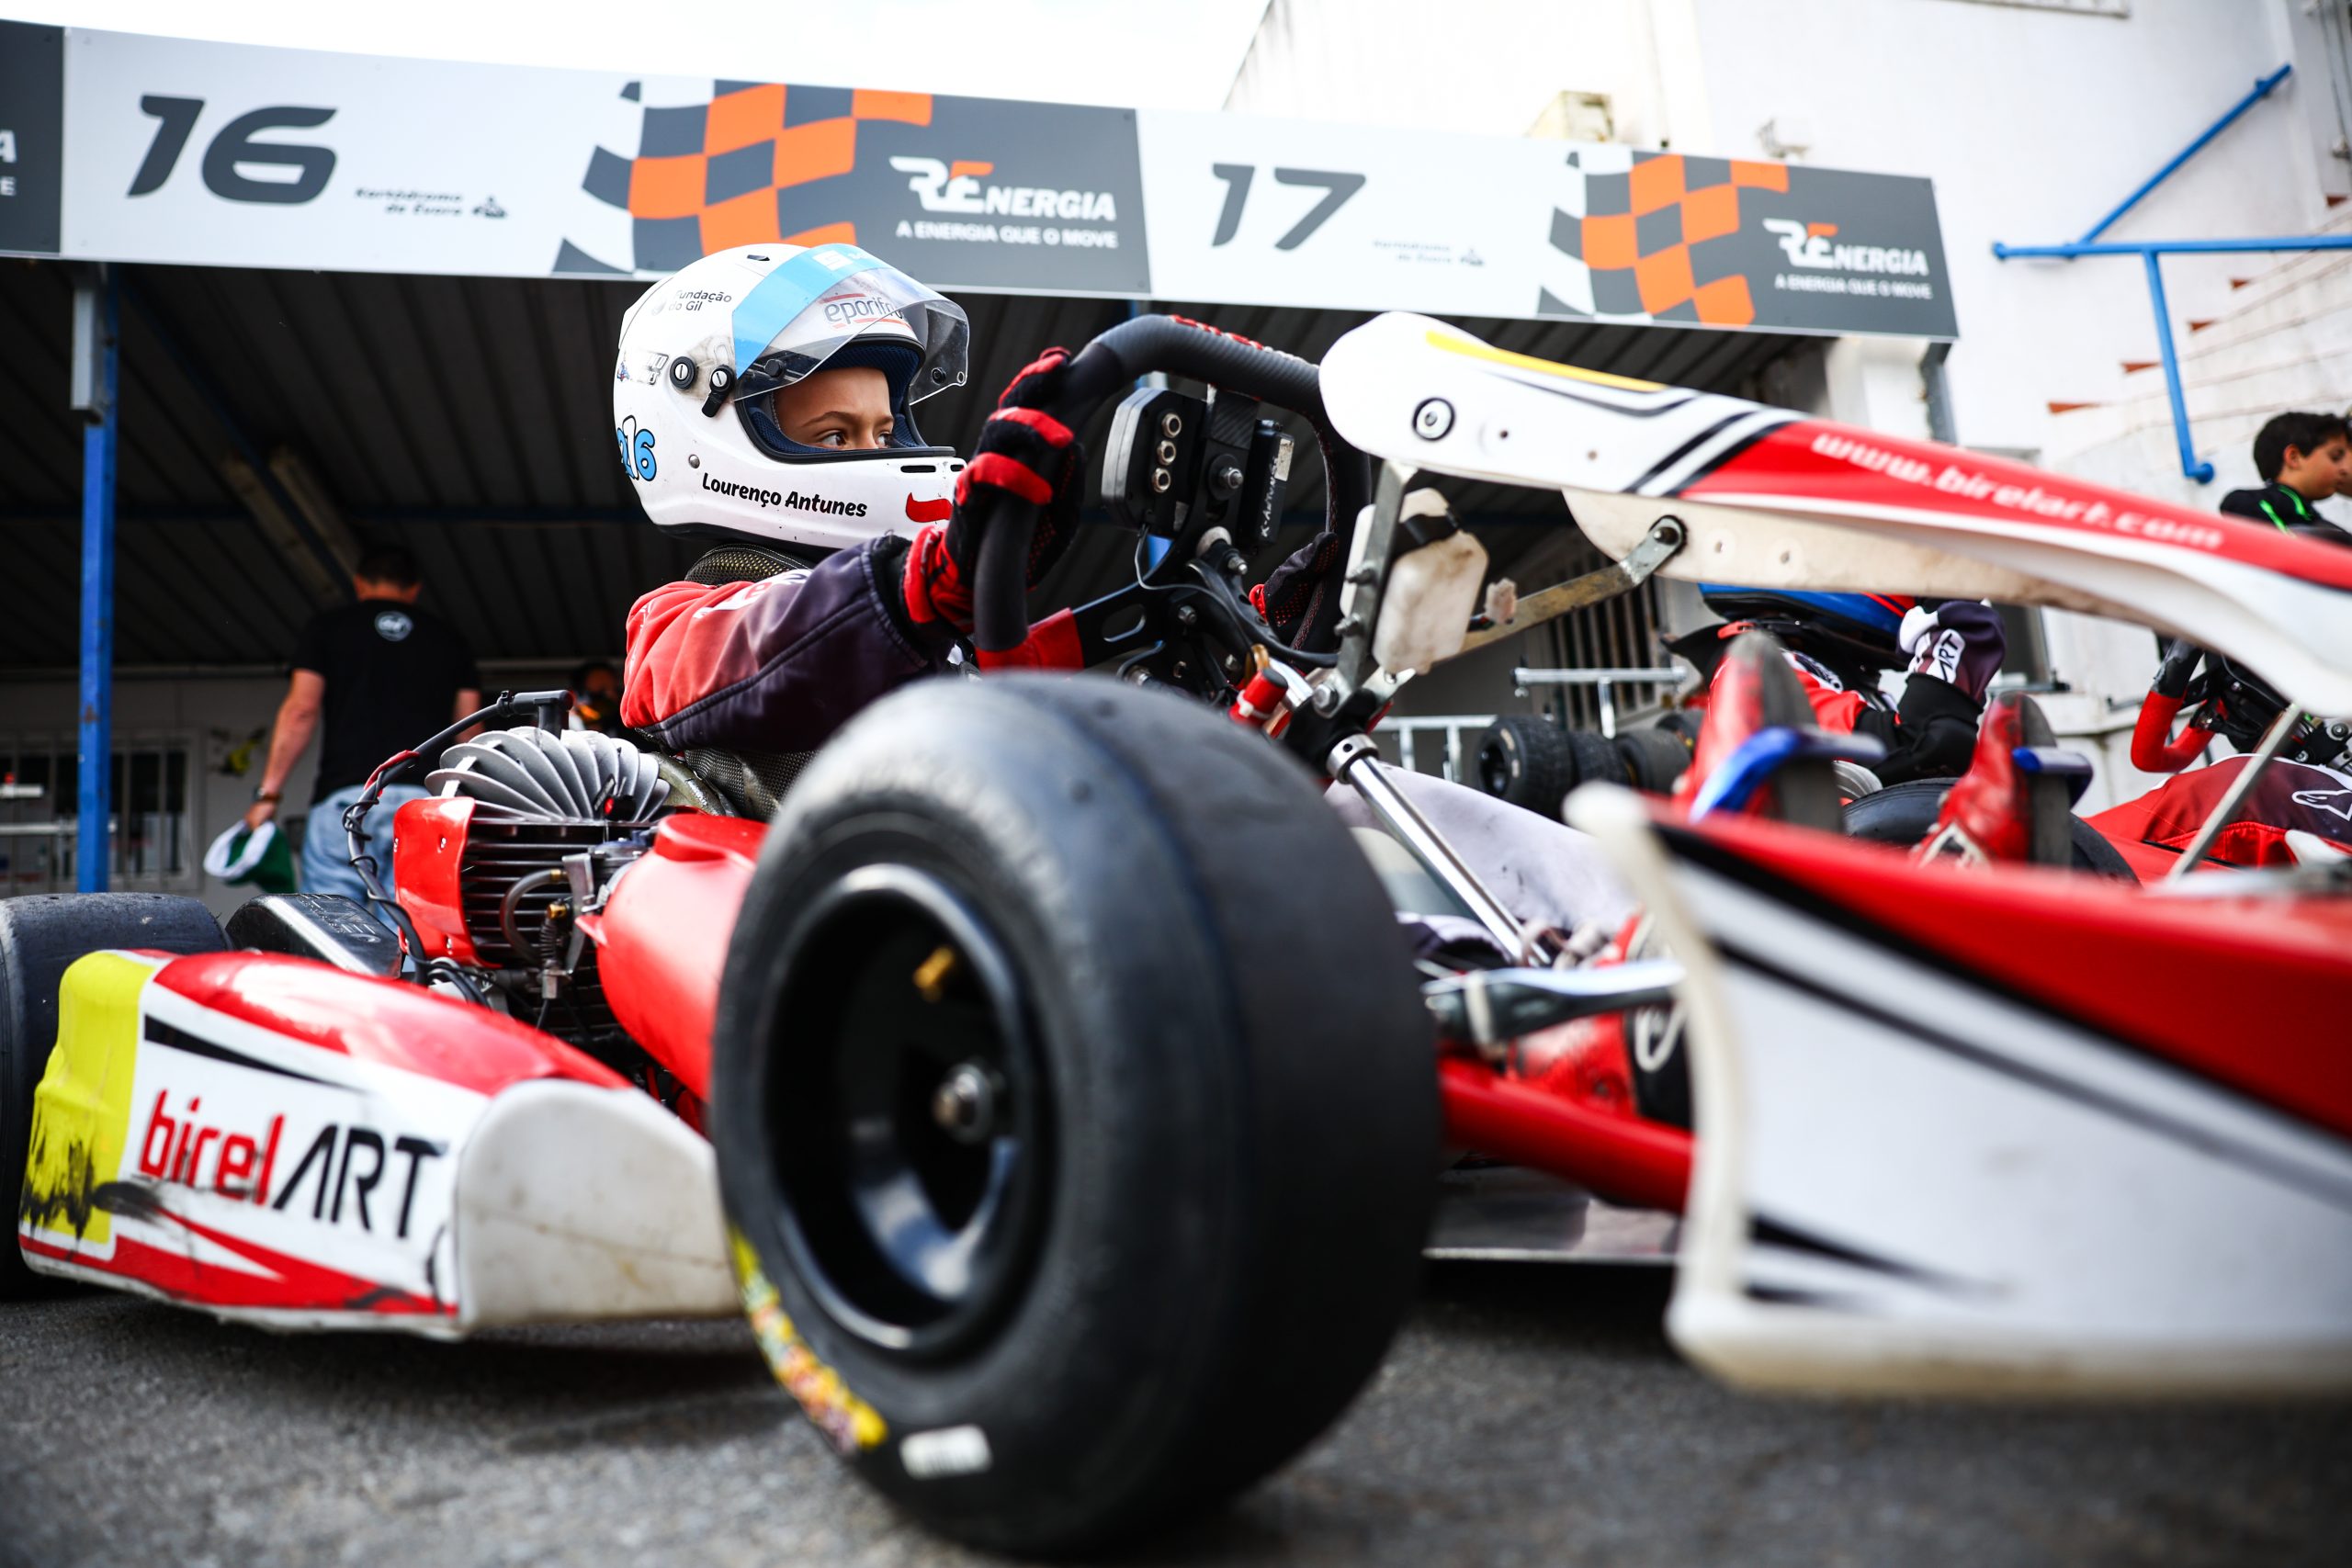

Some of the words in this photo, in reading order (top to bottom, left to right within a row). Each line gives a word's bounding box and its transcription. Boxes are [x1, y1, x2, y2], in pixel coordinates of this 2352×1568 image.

[127, 94, 337, 205] 16
[1211, 163, 1367, 251] 17
[895, 220, 912, 239] A
[913, 220, 999, 243] ENERGIA
[1000, 225, 1042, 244] QUE
[1042, 228, 1061, 245] O
[1062, 229, 1119, 249] MOVE
[674, 289, 732, 303] Fundação
[1787, 273, 1847, 294] ENERGIA
[1848, 277, 1878, 296] QUE
[1891, 281, 1933, 300] MOVE
[668, 301, 683, 311] do
[685, 300, 703, 311] Gil
[702, 472, 782, 508] Lourenço
[784, 491, 868, 518] Antunes
[1811, 433, 2225, 549] www.birelart.com
